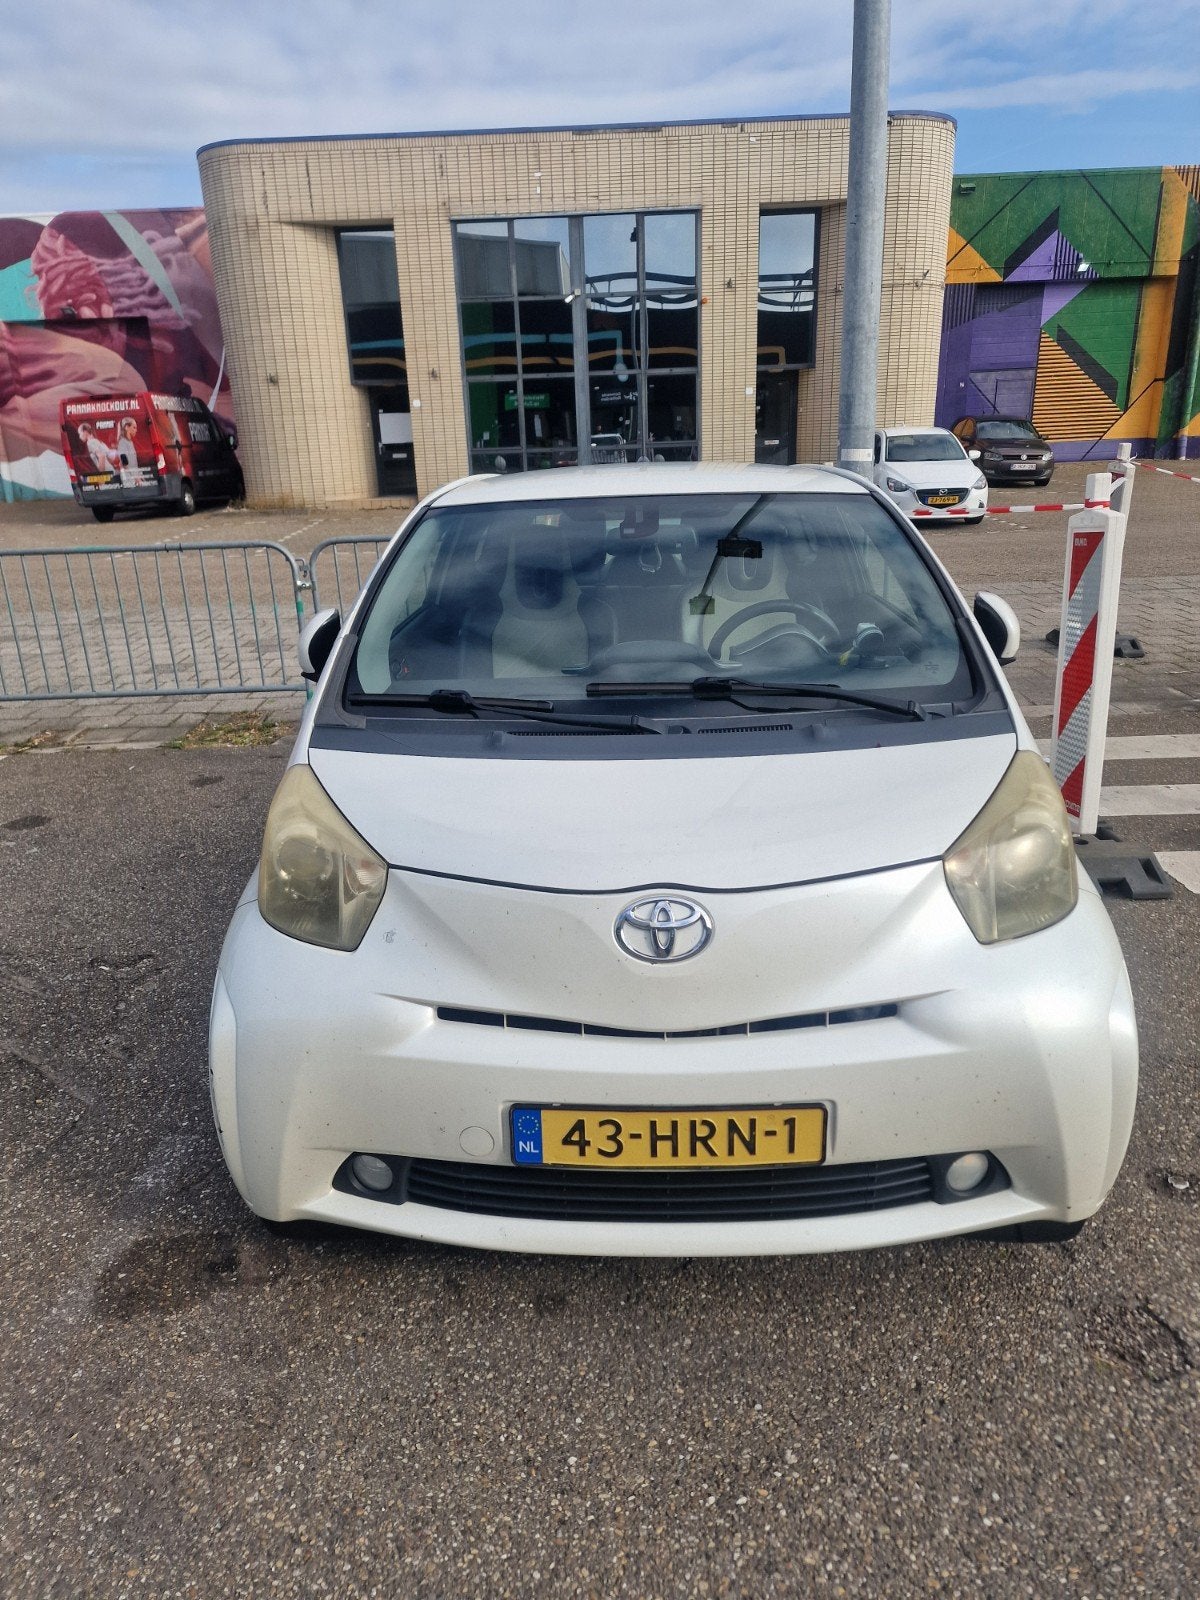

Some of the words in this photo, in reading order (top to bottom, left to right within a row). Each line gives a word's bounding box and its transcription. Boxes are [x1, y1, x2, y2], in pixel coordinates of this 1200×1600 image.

[66, 398, 140, 415] PANNAKNOCKOUT.NL
[561, 1117, 797, 1158] 43-HRN-1
[519, 1140, 540, 1154] NL
